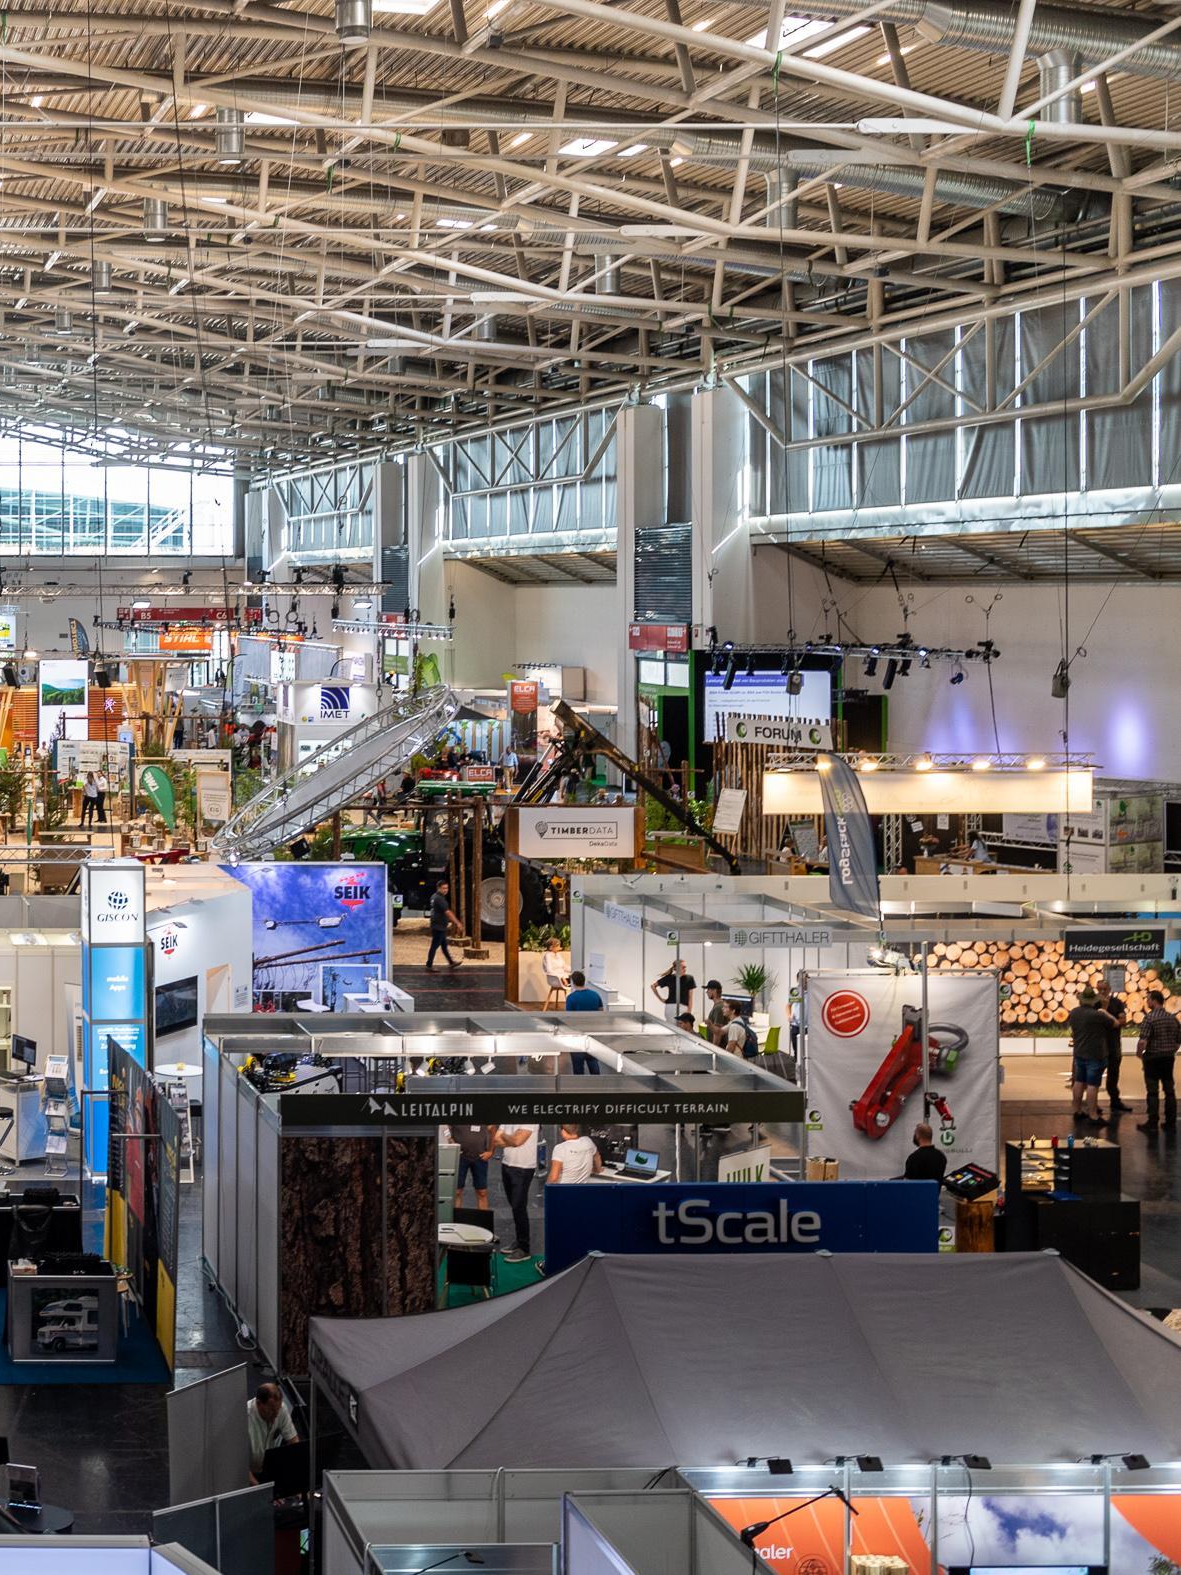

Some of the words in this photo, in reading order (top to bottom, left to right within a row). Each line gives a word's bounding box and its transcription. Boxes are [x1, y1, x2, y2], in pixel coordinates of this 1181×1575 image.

[140, 612, 152, 620] B5
[215, 612, 228, 620] C6
[163, 634, 200, 644] STIHL
[514, 685, 536, 694] ELCA
[320, 711, 350, 719] IMET
[754, 726, 803, 742] FORUM
[468, 769, 493, 777] ELCA
[551, 826, 614, 834] TIMBERDATA
[334, 885, 371, 900] SEIK
[97, 913, 139, 922] GISCON
[160, 934, 179, 951] SEIK
[749, 931, 830, 945] GIFTTHALER
[1069, 942, 1160, 953] Heidegesellschaft
[401, 1103, 474, 1117] LEITALPIN
[509, 1105, 529, 1115] WE
[533, 1104, 600, 1115] ELECTRIFY
[605, 1104, 670, 1114] DIFFICULT
[674, 1103, 730, 1114] TERRAIN
[652, 1199, 822, 1244] tScale
[755, 1543, 795, 1560] aler
